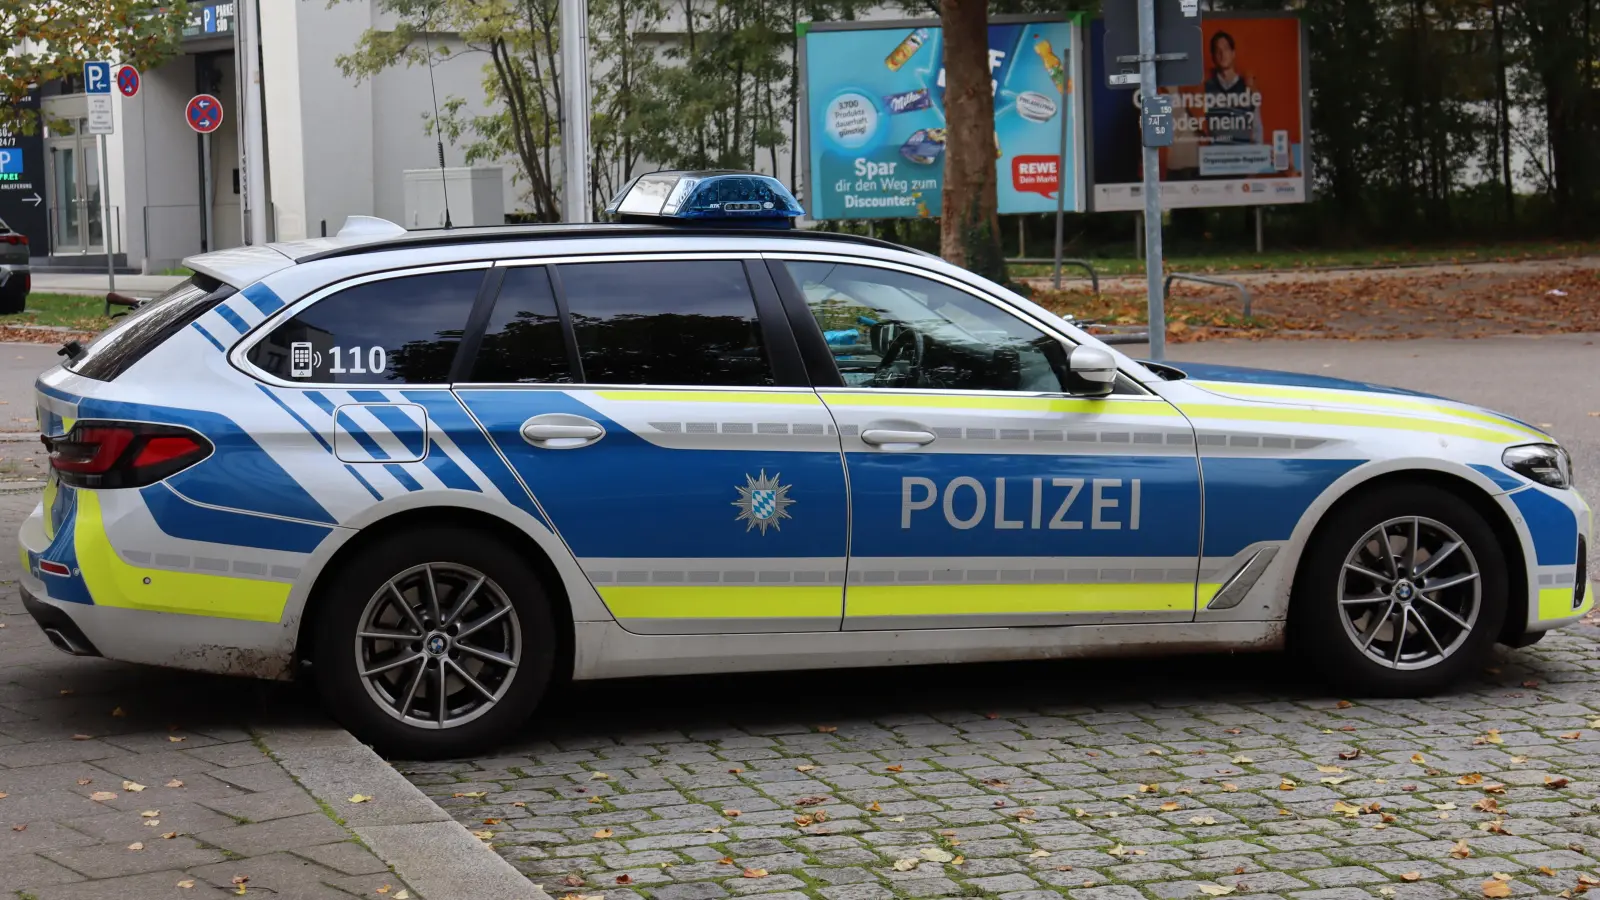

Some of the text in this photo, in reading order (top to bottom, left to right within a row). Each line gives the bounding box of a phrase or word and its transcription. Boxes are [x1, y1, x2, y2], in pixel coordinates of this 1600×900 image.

[216, 4, 234, 17] PARKE
[88, 65, 103, 90] P
[1133, 87, 1262, 113] Oanspende
[1208, 111, 1254, 131] nein?
[855, 158, 897, 180] Spar
[1018, 162, 1058, 175] REWE
[835, 177, 937, 193] dir den Weg zum
[1019, 174, 1058, 185] Dein Markt
[329, 345, 387, 374] 110
[900, 476, 1141, 530] POLIZEI
